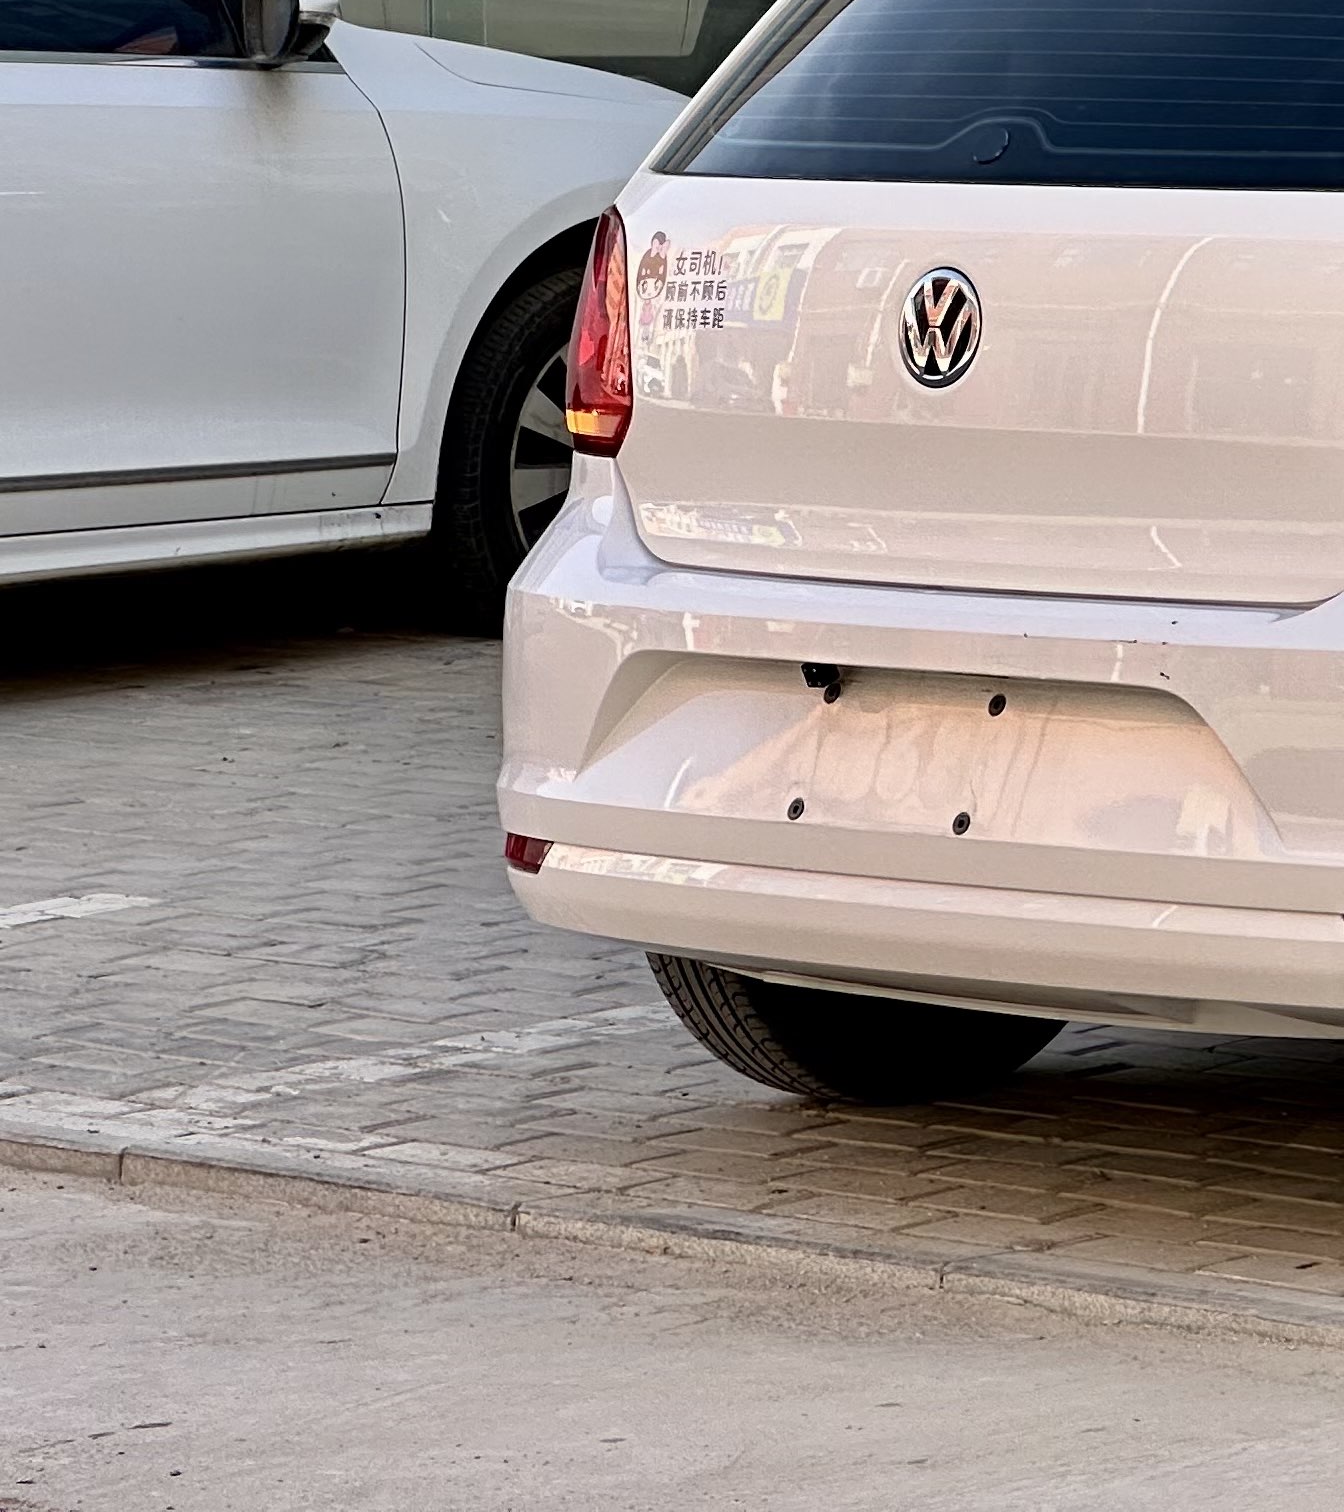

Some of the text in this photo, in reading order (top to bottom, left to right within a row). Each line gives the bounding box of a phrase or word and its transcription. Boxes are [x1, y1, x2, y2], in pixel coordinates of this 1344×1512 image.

[664, 279, 728, 303] 顾前不顾后
[662, 307, 725, 330] 请保持车距
